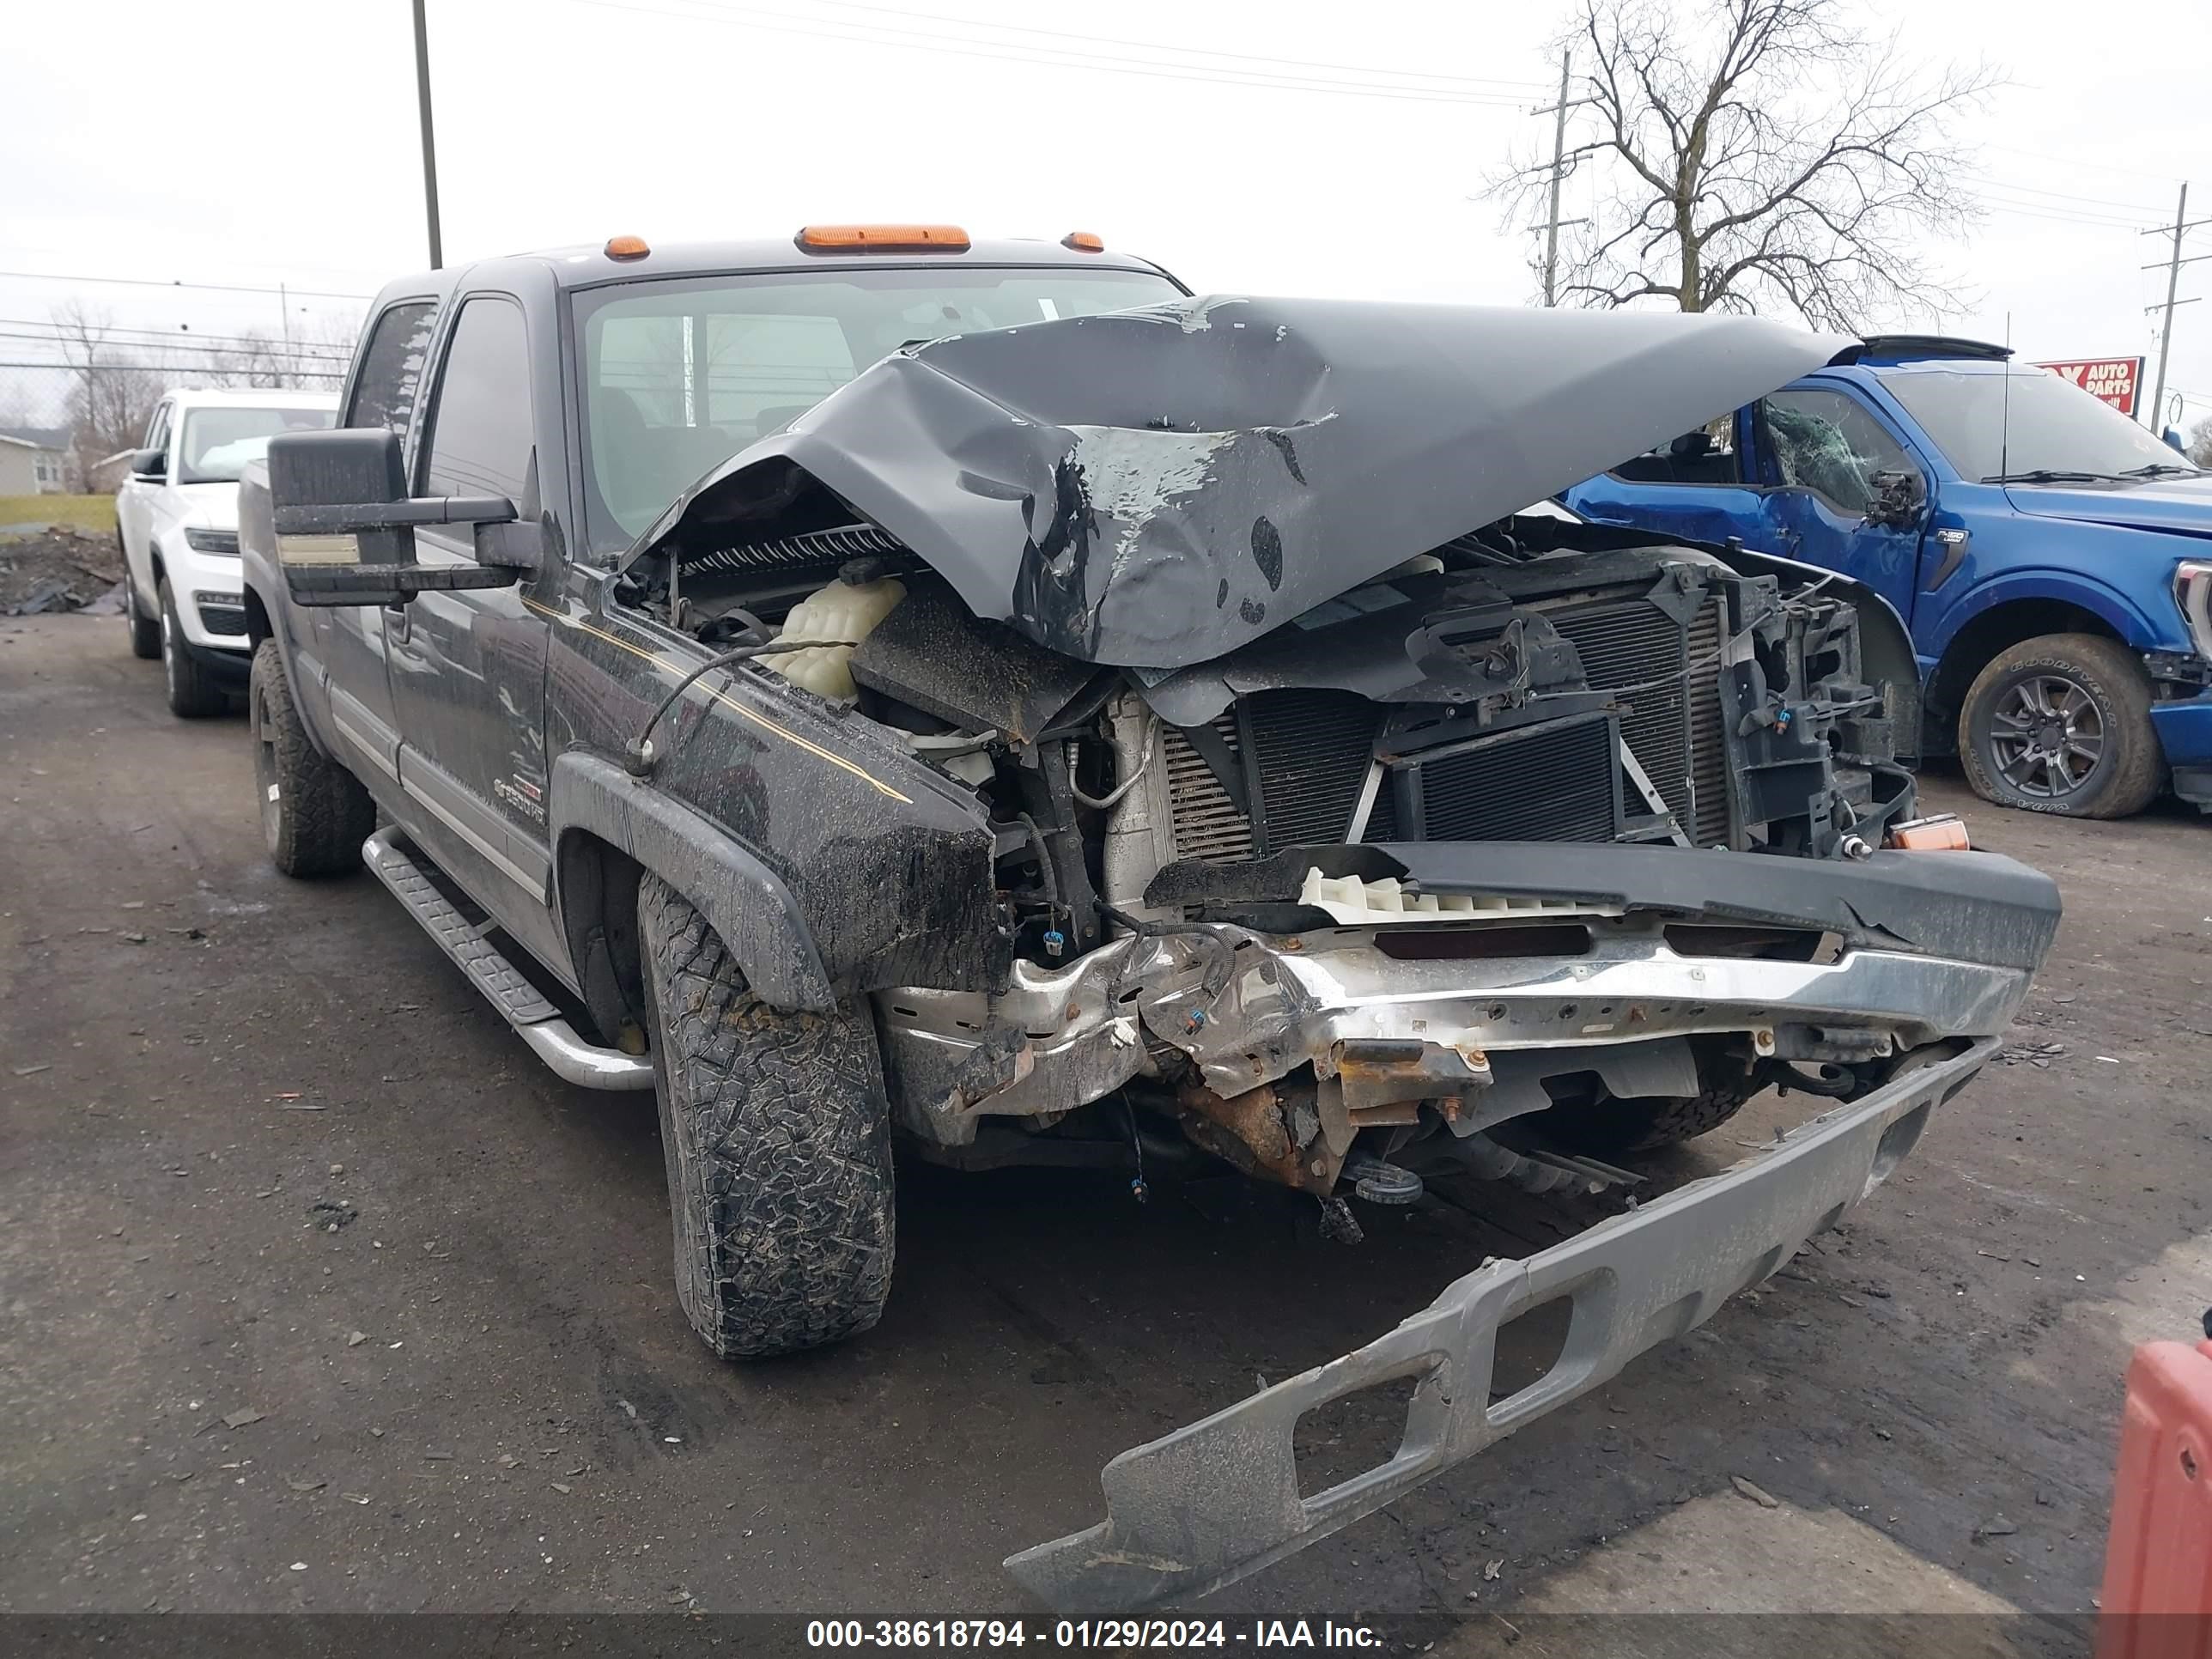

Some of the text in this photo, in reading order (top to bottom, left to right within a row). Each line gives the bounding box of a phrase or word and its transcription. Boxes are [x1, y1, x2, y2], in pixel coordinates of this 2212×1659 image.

[2087, 363, 2129, 380] AUTO
[2086, 379, 2131, 395] PARTS
[2010, 658, 2118, 729] GOODYEAR
